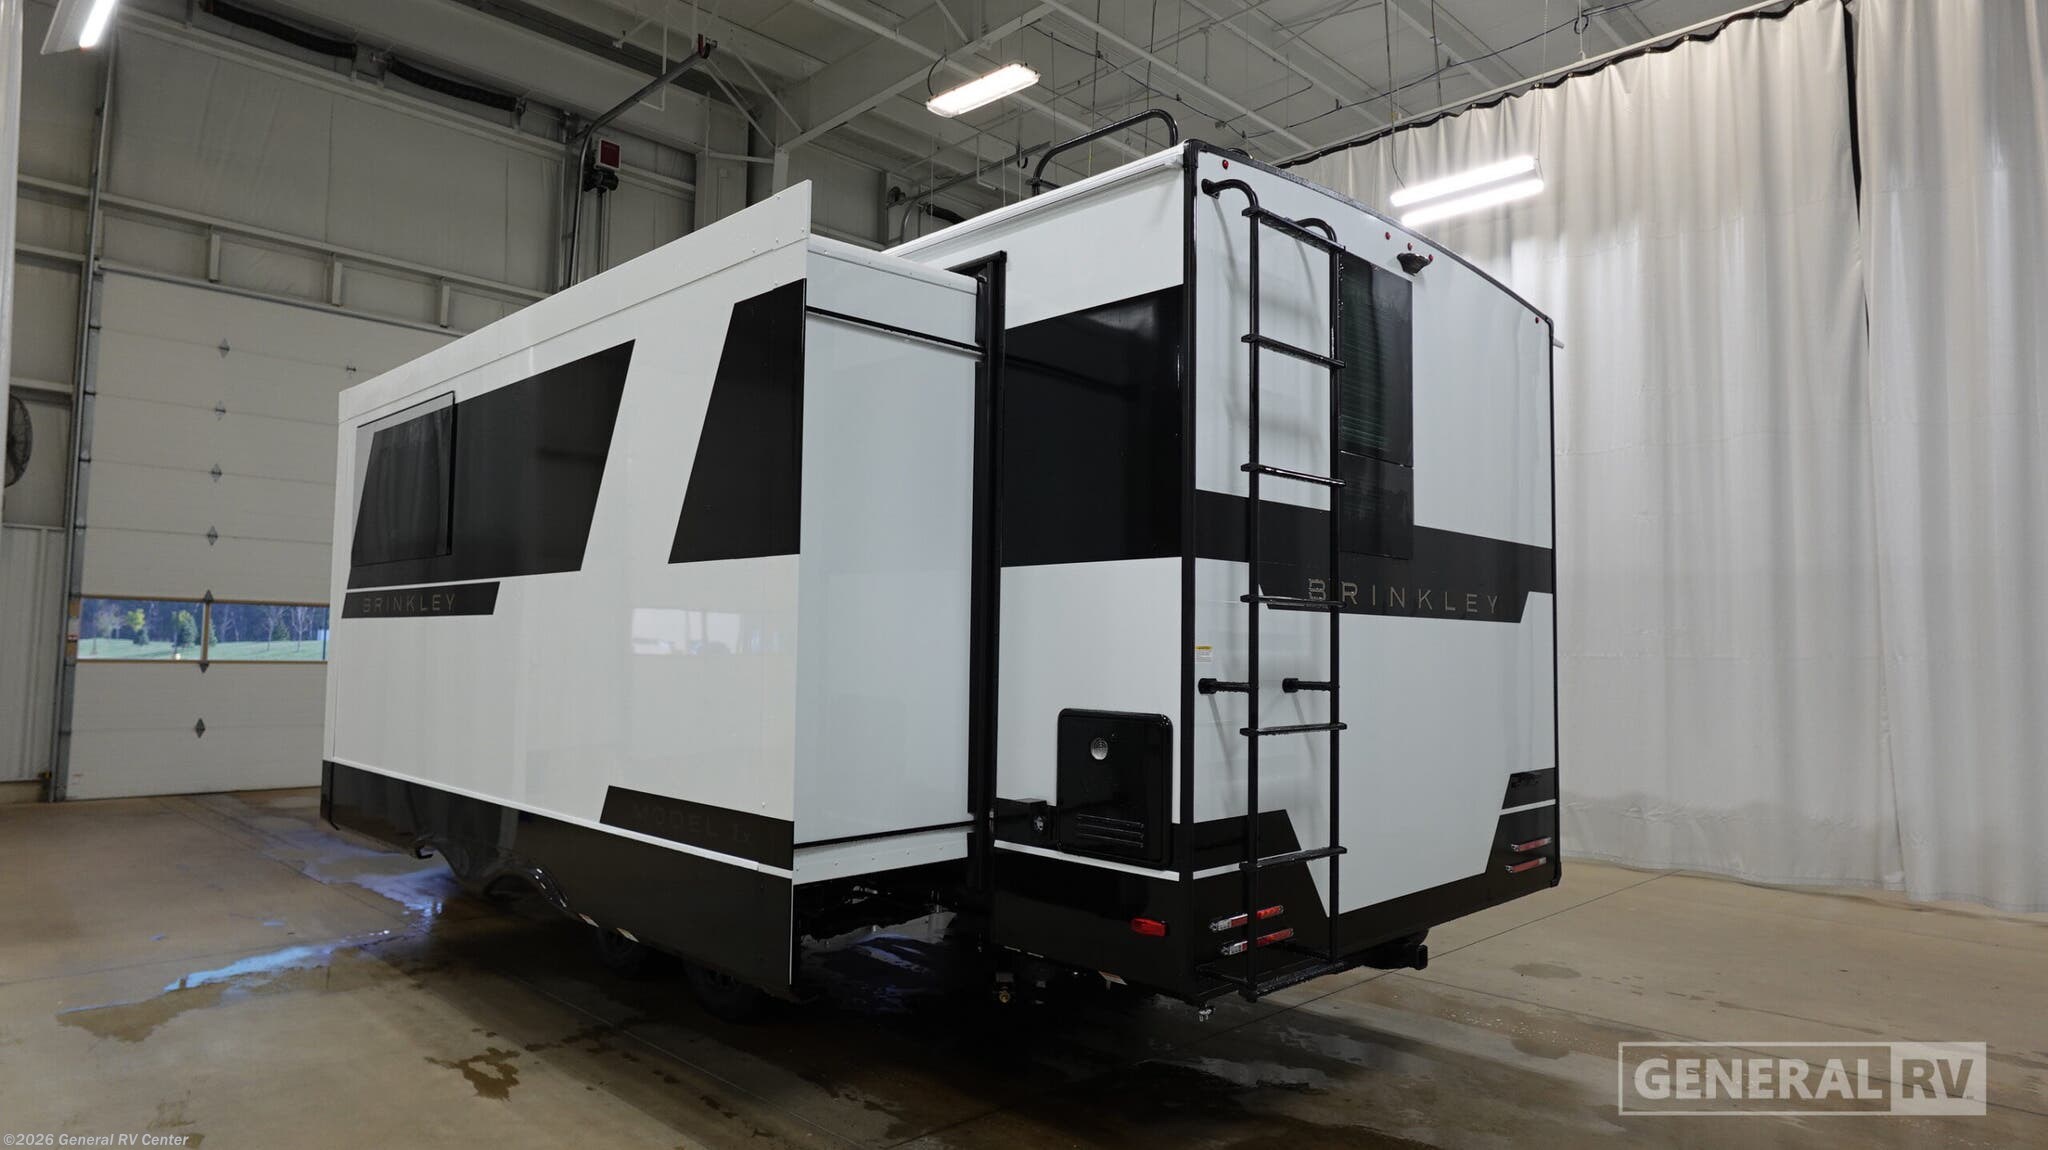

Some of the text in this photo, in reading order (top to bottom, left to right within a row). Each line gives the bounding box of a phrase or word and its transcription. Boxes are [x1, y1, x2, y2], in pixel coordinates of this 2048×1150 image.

[362, 592, 457, 614] BRINKLEY
[1308, 577, 1499, 614] BRINKLEY
[631, 802, 719, 839] MODEL
